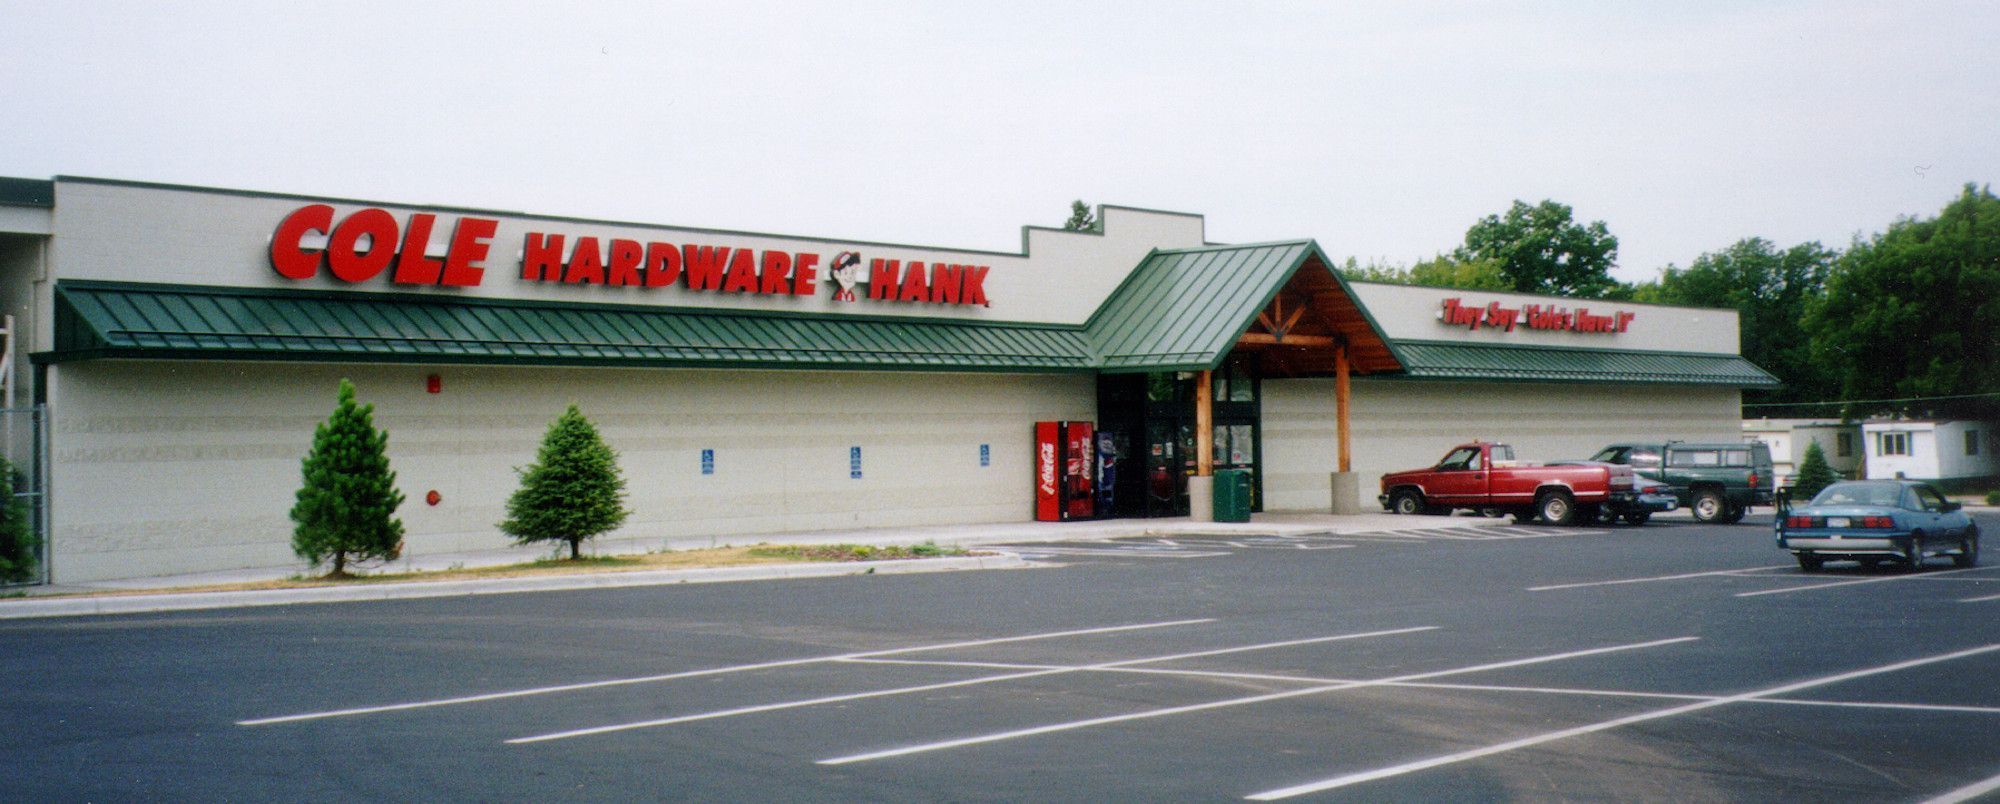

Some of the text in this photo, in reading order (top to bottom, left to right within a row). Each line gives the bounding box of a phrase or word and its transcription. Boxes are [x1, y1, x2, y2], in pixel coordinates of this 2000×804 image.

[271, 204, 991, 306] COLE HARDWARE HANK
[1487, 301, 1520, 333] Say
[1575, 307, 1614, 333] Have
